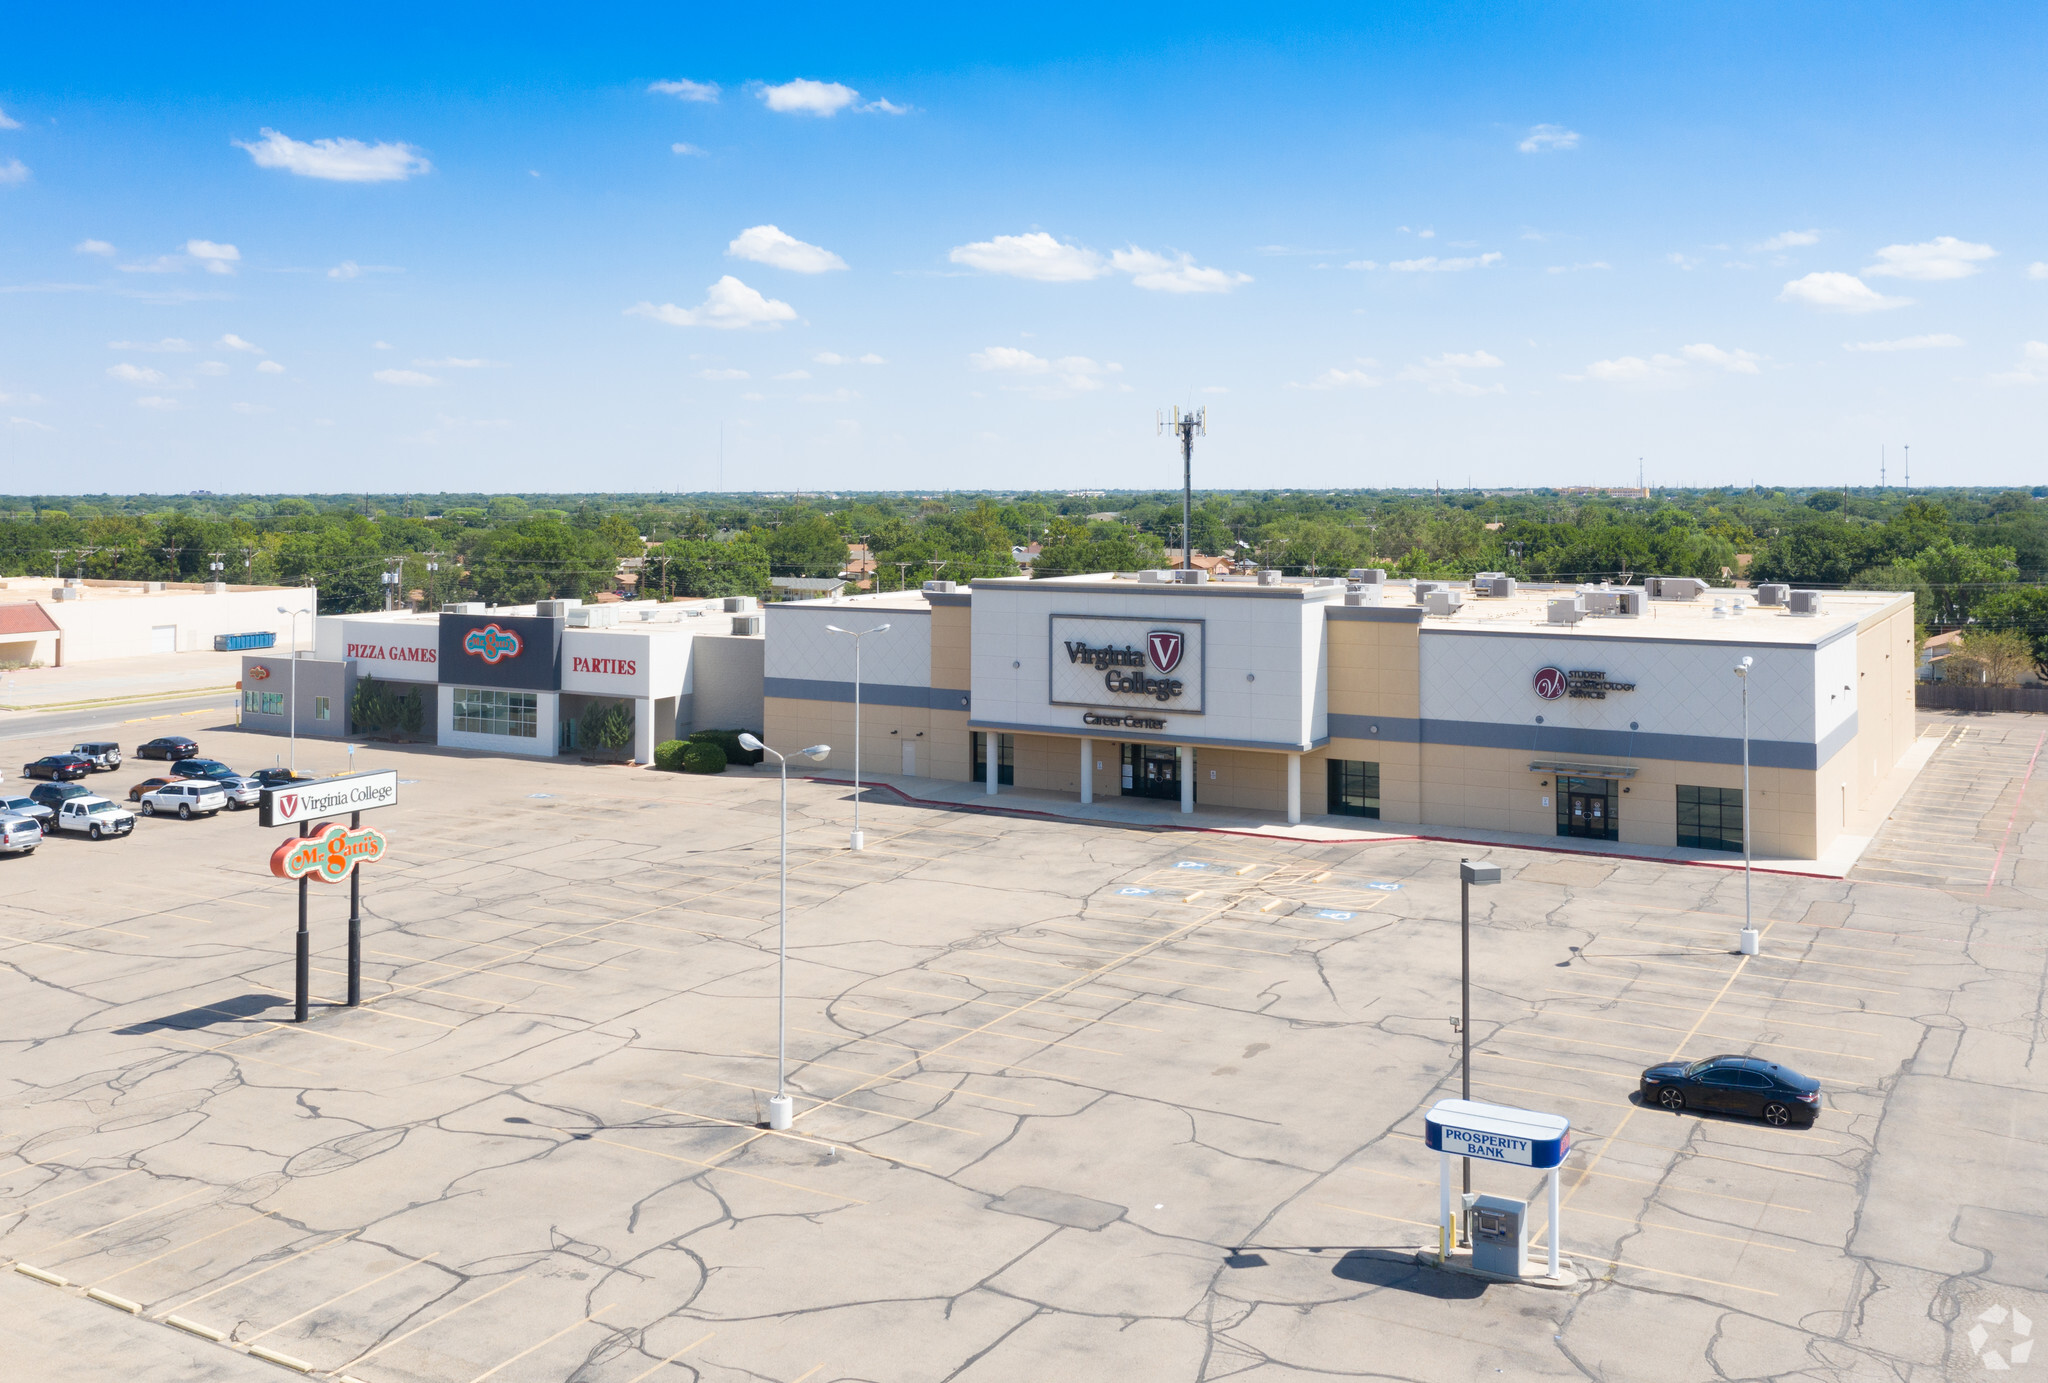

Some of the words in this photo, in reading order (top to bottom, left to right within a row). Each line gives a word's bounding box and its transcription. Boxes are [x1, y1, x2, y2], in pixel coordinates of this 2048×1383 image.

[347, 643, 386, 660] PIZZA
[389, 646, 437, 663] GAMES
[1064, 641, 1145, 670] Virginia
[572, 656, 637, 676] PARTIES
[1568, 670, 1606, 680] STUDENT
[1105, 670, 1183, 701] College
[1568, 680, 1636, 692] COSMETOLOGY
[1568, 690, 1606, 699] SERVICES
[1083, 712, 1121, 727] Career
[1124, 715, 1166, 730] Center
[301, 791, 348, 812] Virginia
[350, 785, 393, 803] College
[292, 847, 324, 870] Mr.
[1445, 1129, 1528, 1151] PROSPERITY
[1467, 1143, 1505, 1159] BANK
